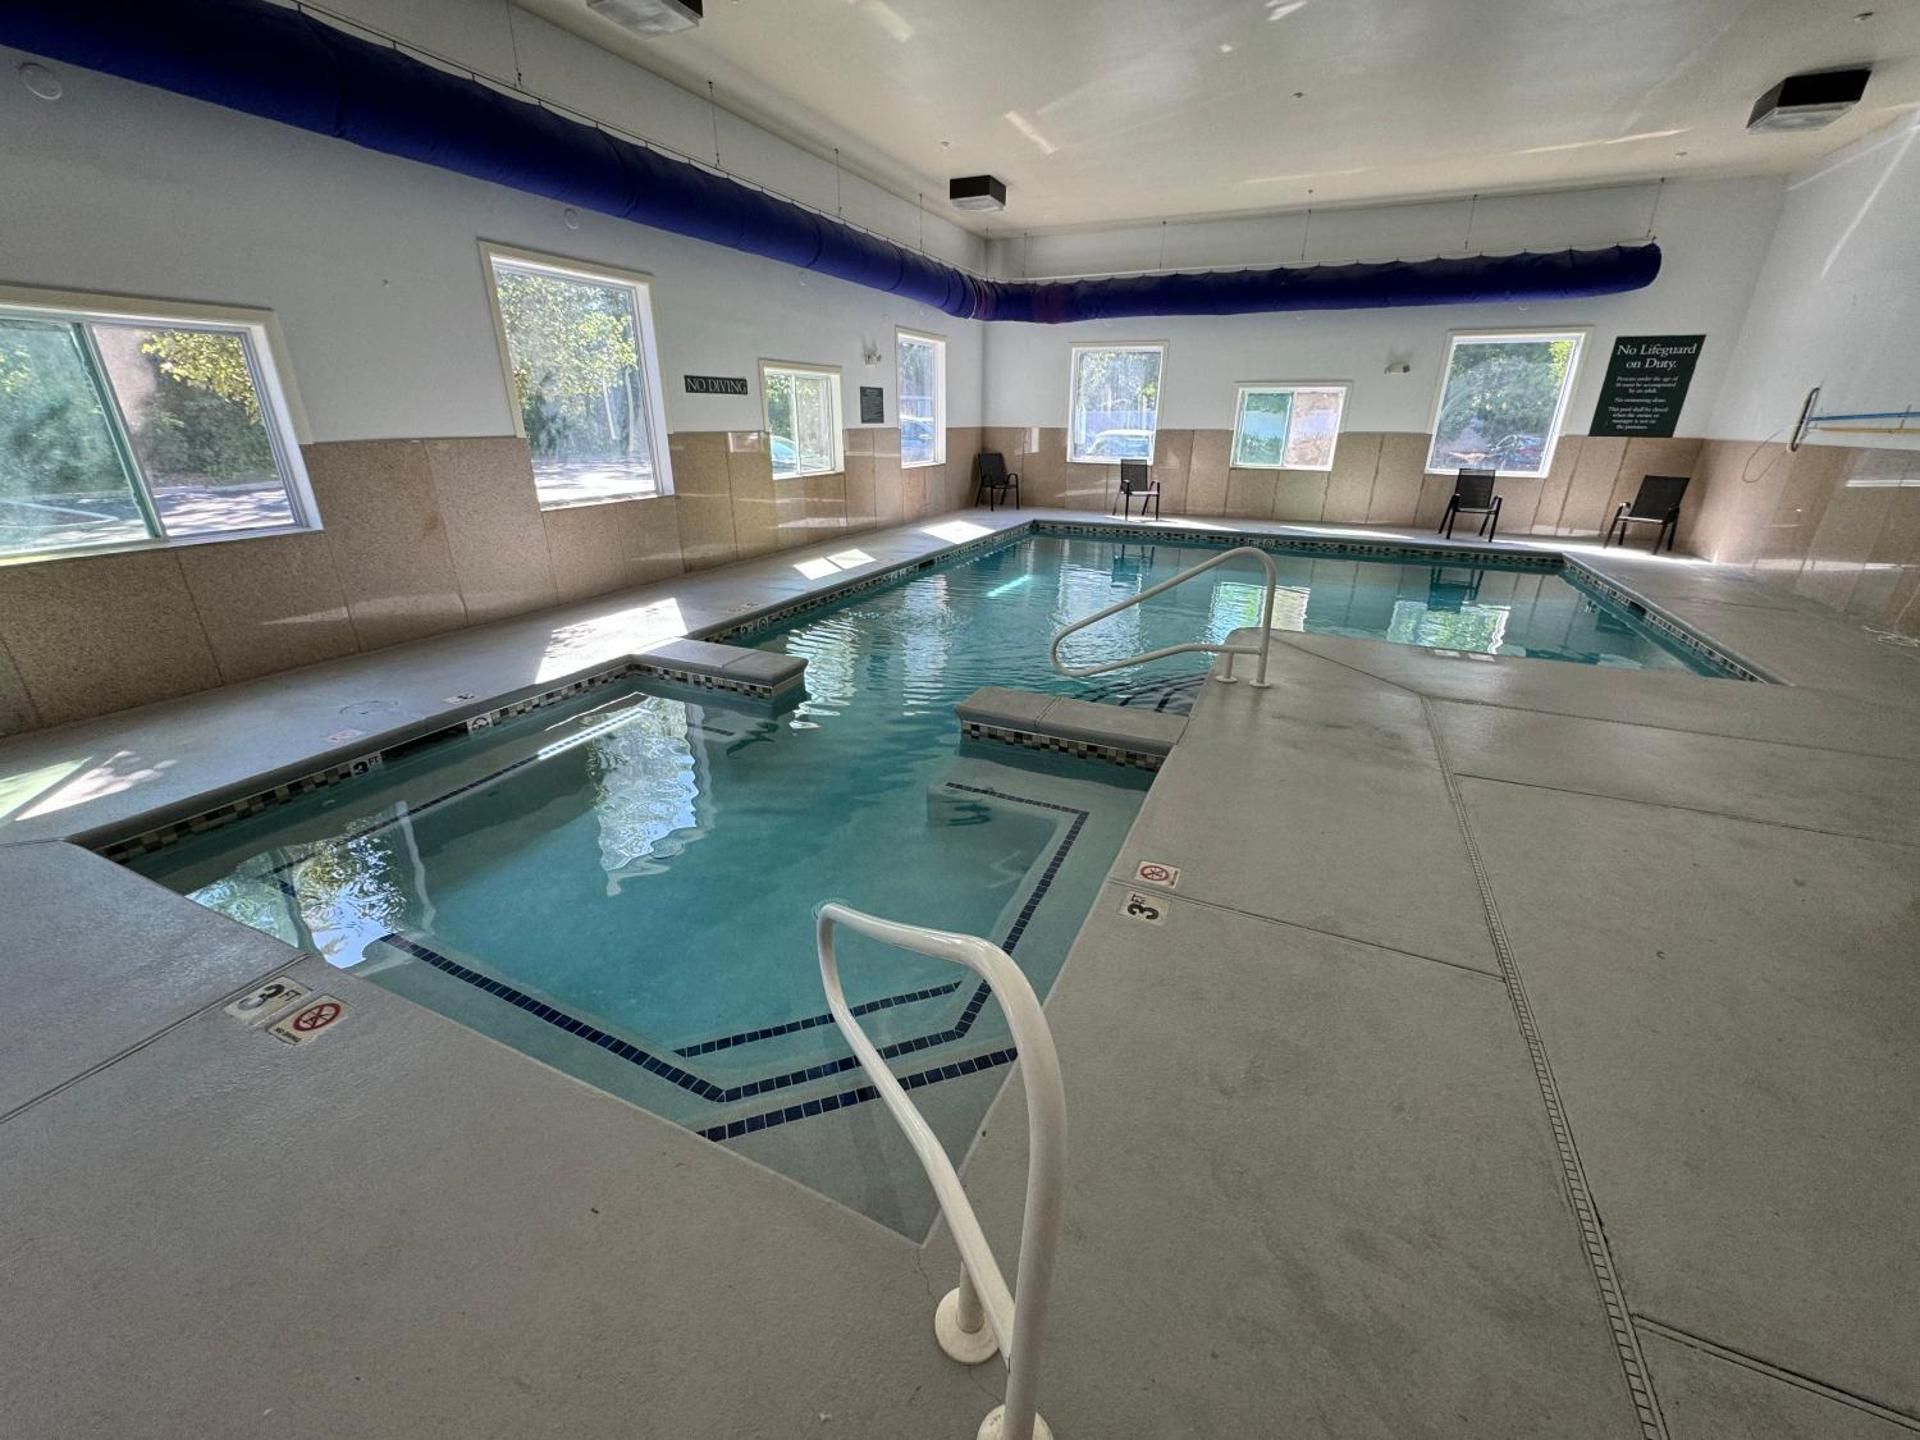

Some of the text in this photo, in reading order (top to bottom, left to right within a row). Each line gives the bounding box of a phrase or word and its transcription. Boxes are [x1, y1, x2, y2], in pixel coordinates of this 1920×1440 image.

[1617, 343, 1698, 357] No Lifeguard
[1626, 361, 1641, 369] on
[687, 378, 747, 393] NO DIVING
[1127, 903, 1159, 920] 3
[238, 983, 302, 1011] 3 FT
